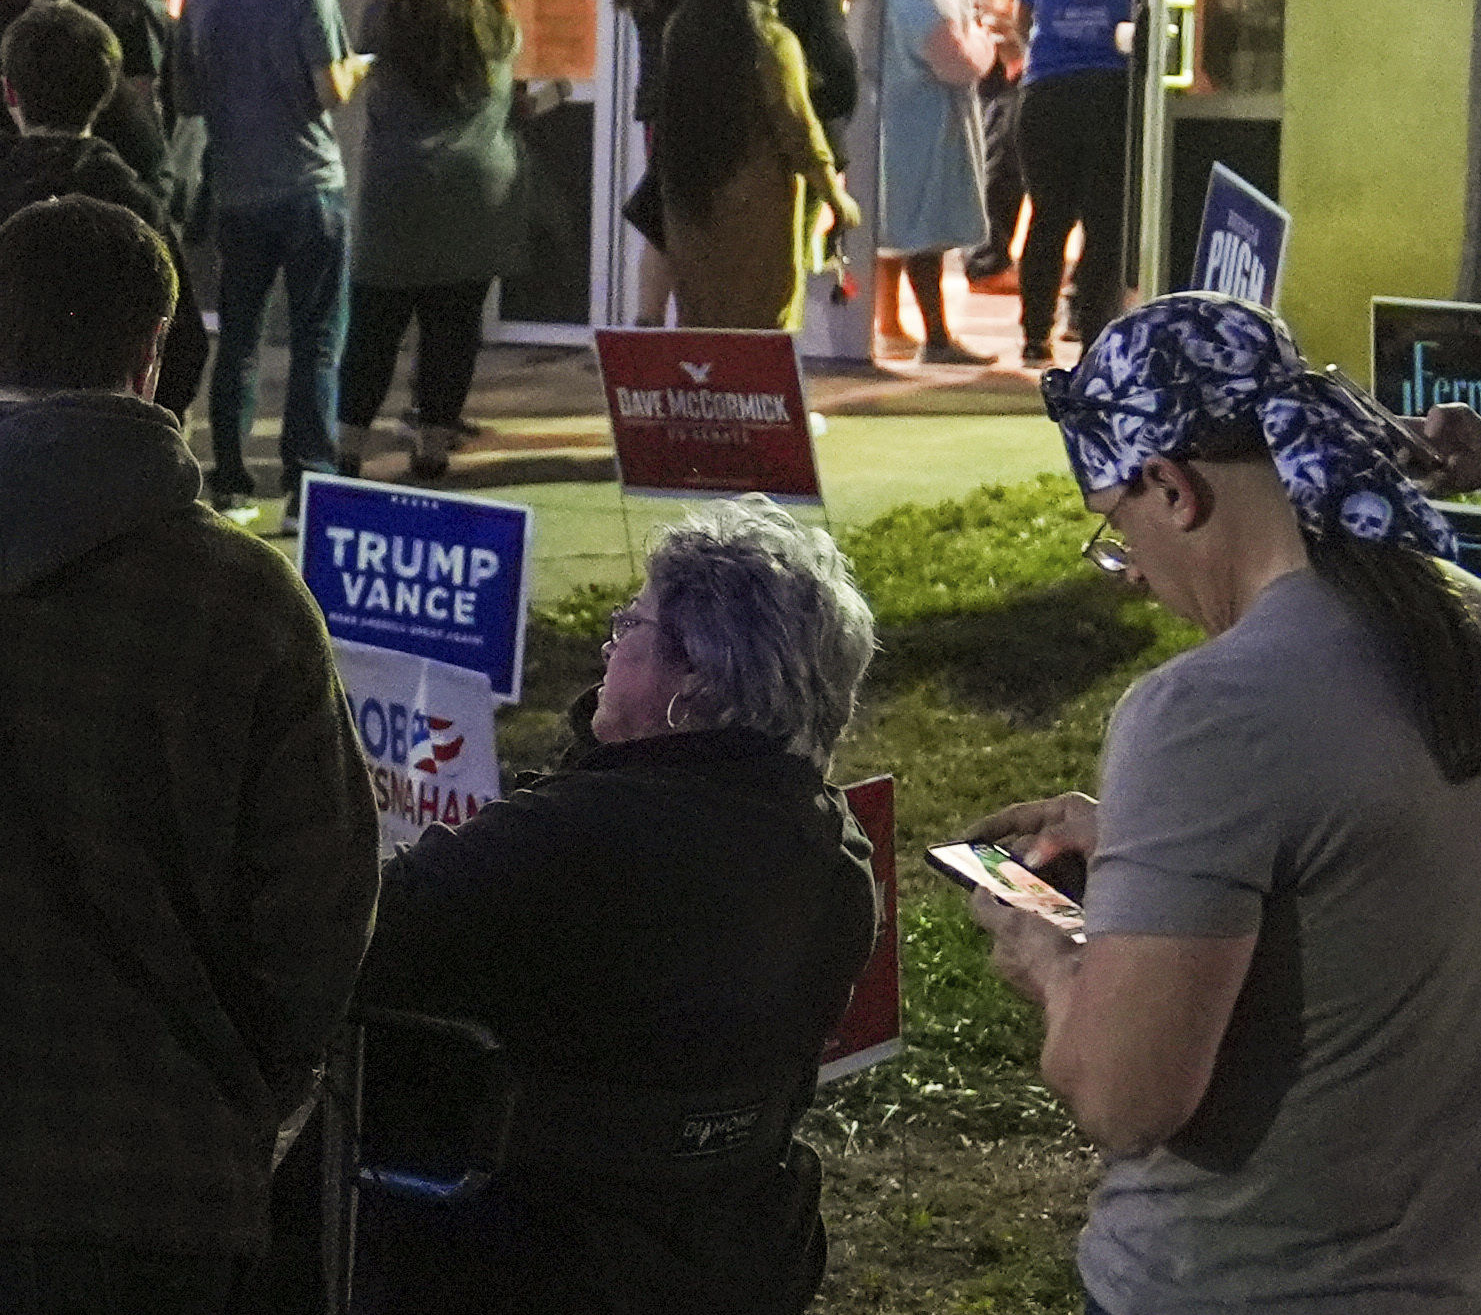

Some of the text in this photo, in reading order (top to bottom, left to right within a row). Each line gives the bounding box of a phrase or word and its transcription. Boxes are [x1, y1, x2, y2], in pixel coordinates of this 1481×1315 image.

[325, 525, 501, 589] TRUMP
[341, 571, 478, 626] VANCE
[347, 695, 409, 765] OB
